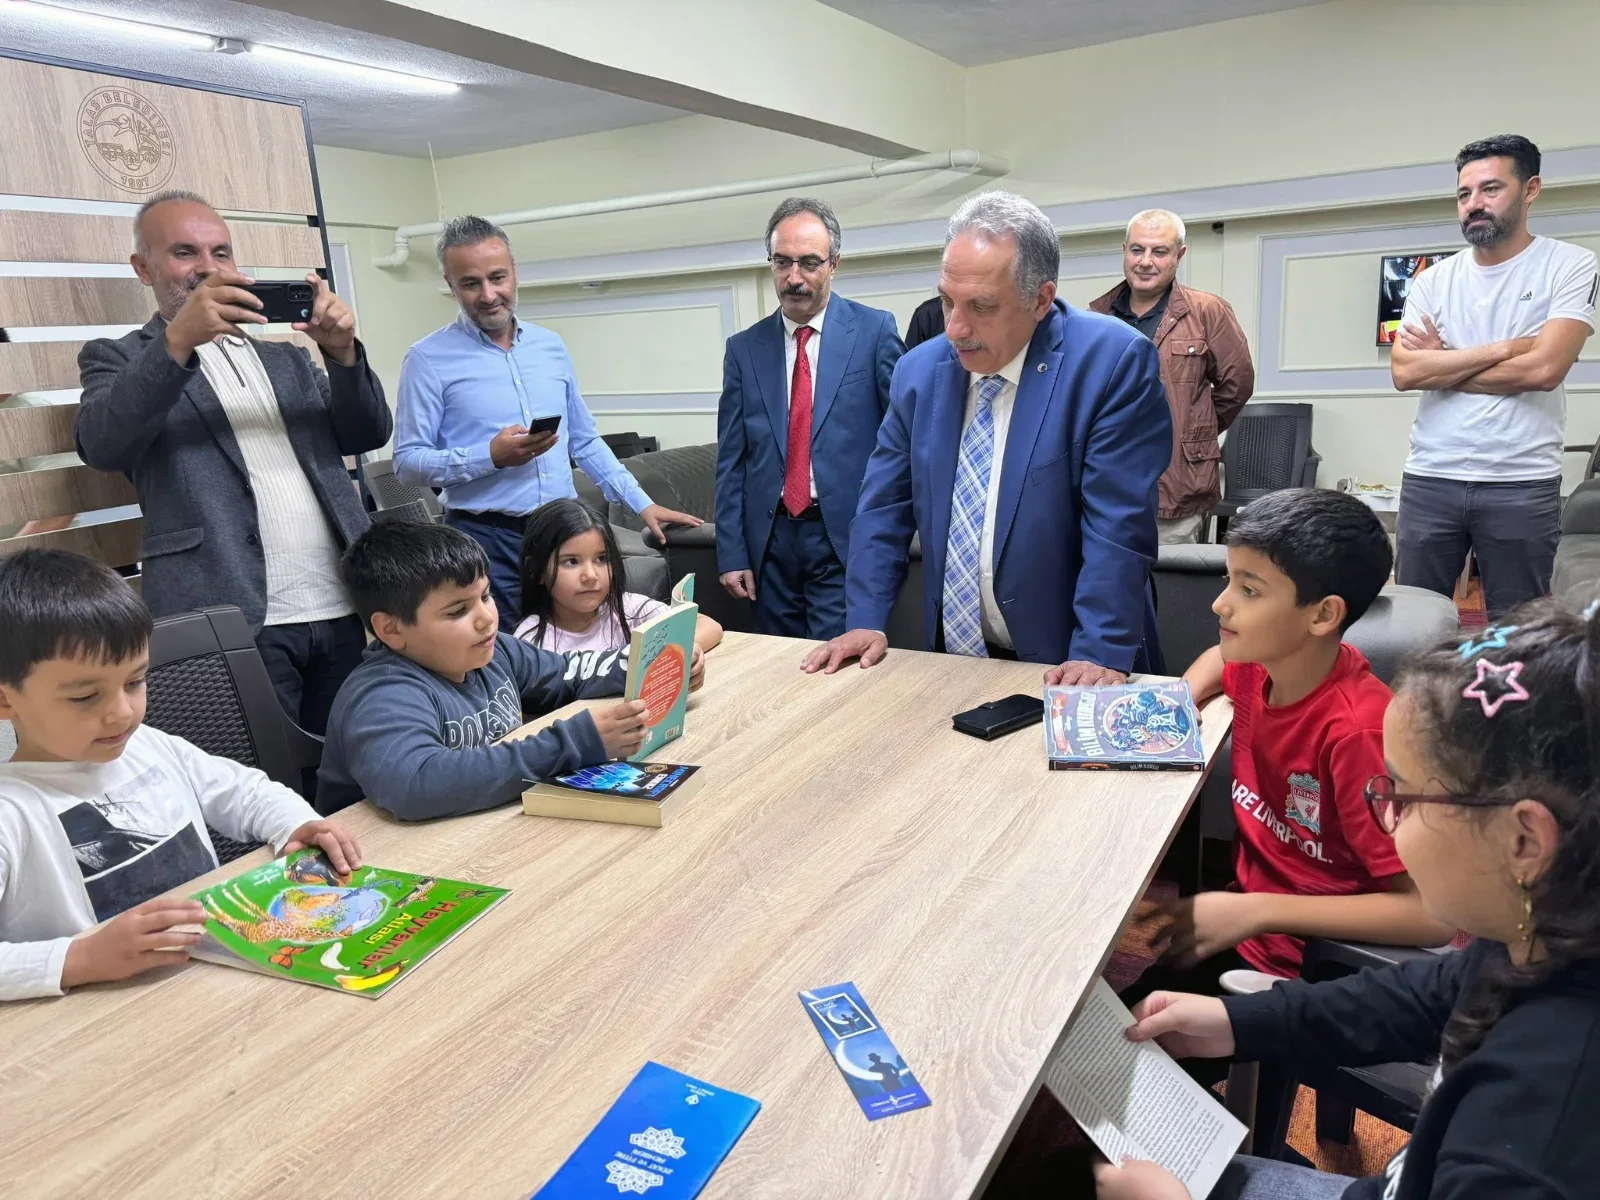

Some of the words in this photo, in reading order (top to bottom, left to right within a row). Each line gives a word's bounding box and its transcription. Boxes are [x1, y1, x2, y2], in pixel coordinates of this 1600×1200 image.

[83, 99, 101, 148] TALAS
[357, 900, 460, 970] Hayvanlar
[361, 912, 414, 945] Atlası
